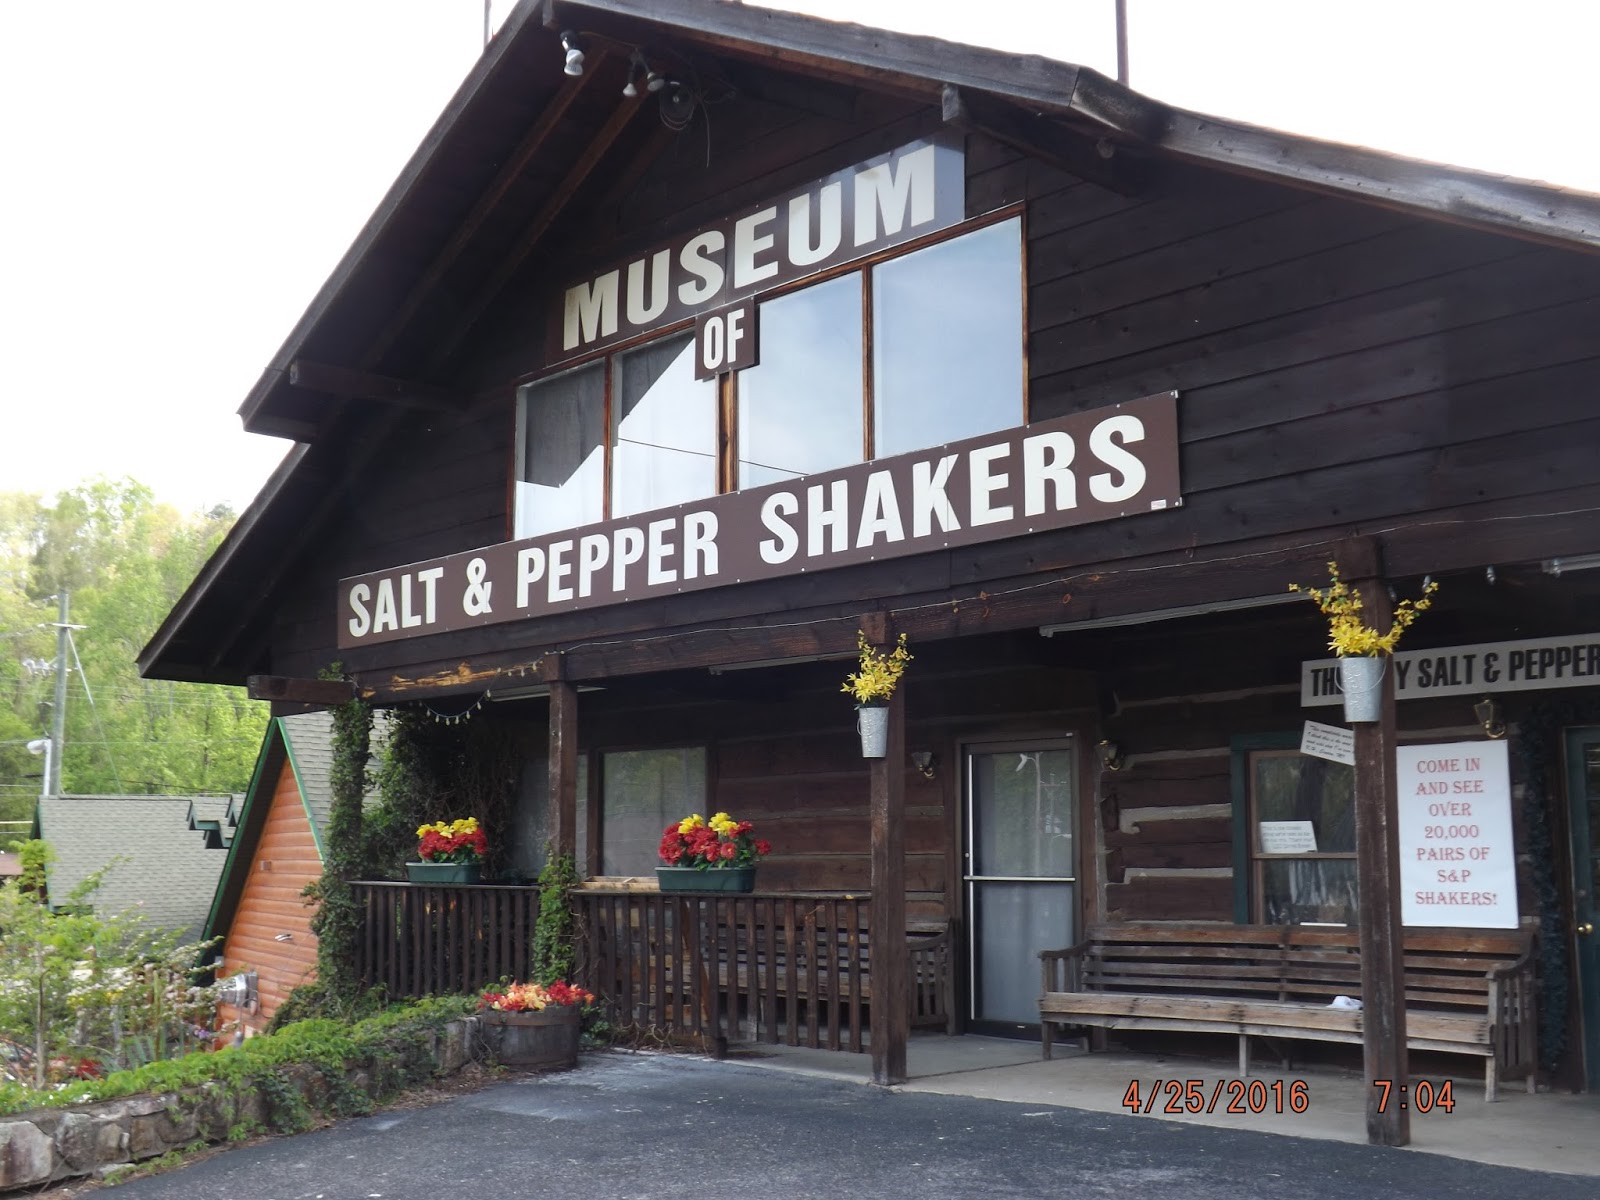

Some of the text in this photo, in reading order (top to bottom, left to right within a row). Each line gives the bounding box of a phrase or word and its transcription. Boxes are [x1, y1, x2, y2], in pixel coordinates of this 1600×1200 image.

[563, 144, 936, 351] MUSEUM
[703, 308, 745, 370] OF
[349, 415, 1147, 638] SALT & PEPPER SHAKERS
[1418, 654, 1476, 688] SALT
[1484, 652, 1501, 683] &
[1508, 643, 1600, 681] PEPPER
[1417, 758, 1481, 773] COME IN
[1416, 780, 1484, 795] AND SEE
[1429, 802, 1472, 816] OVER
[1424, 824, 1479, 839] 20,000
[1417, 847, 1490, 860] PAIRS OF
[1437, 869, 1471, 882] S&P
[1415, 891, 1498, 905] SHAKERS!
